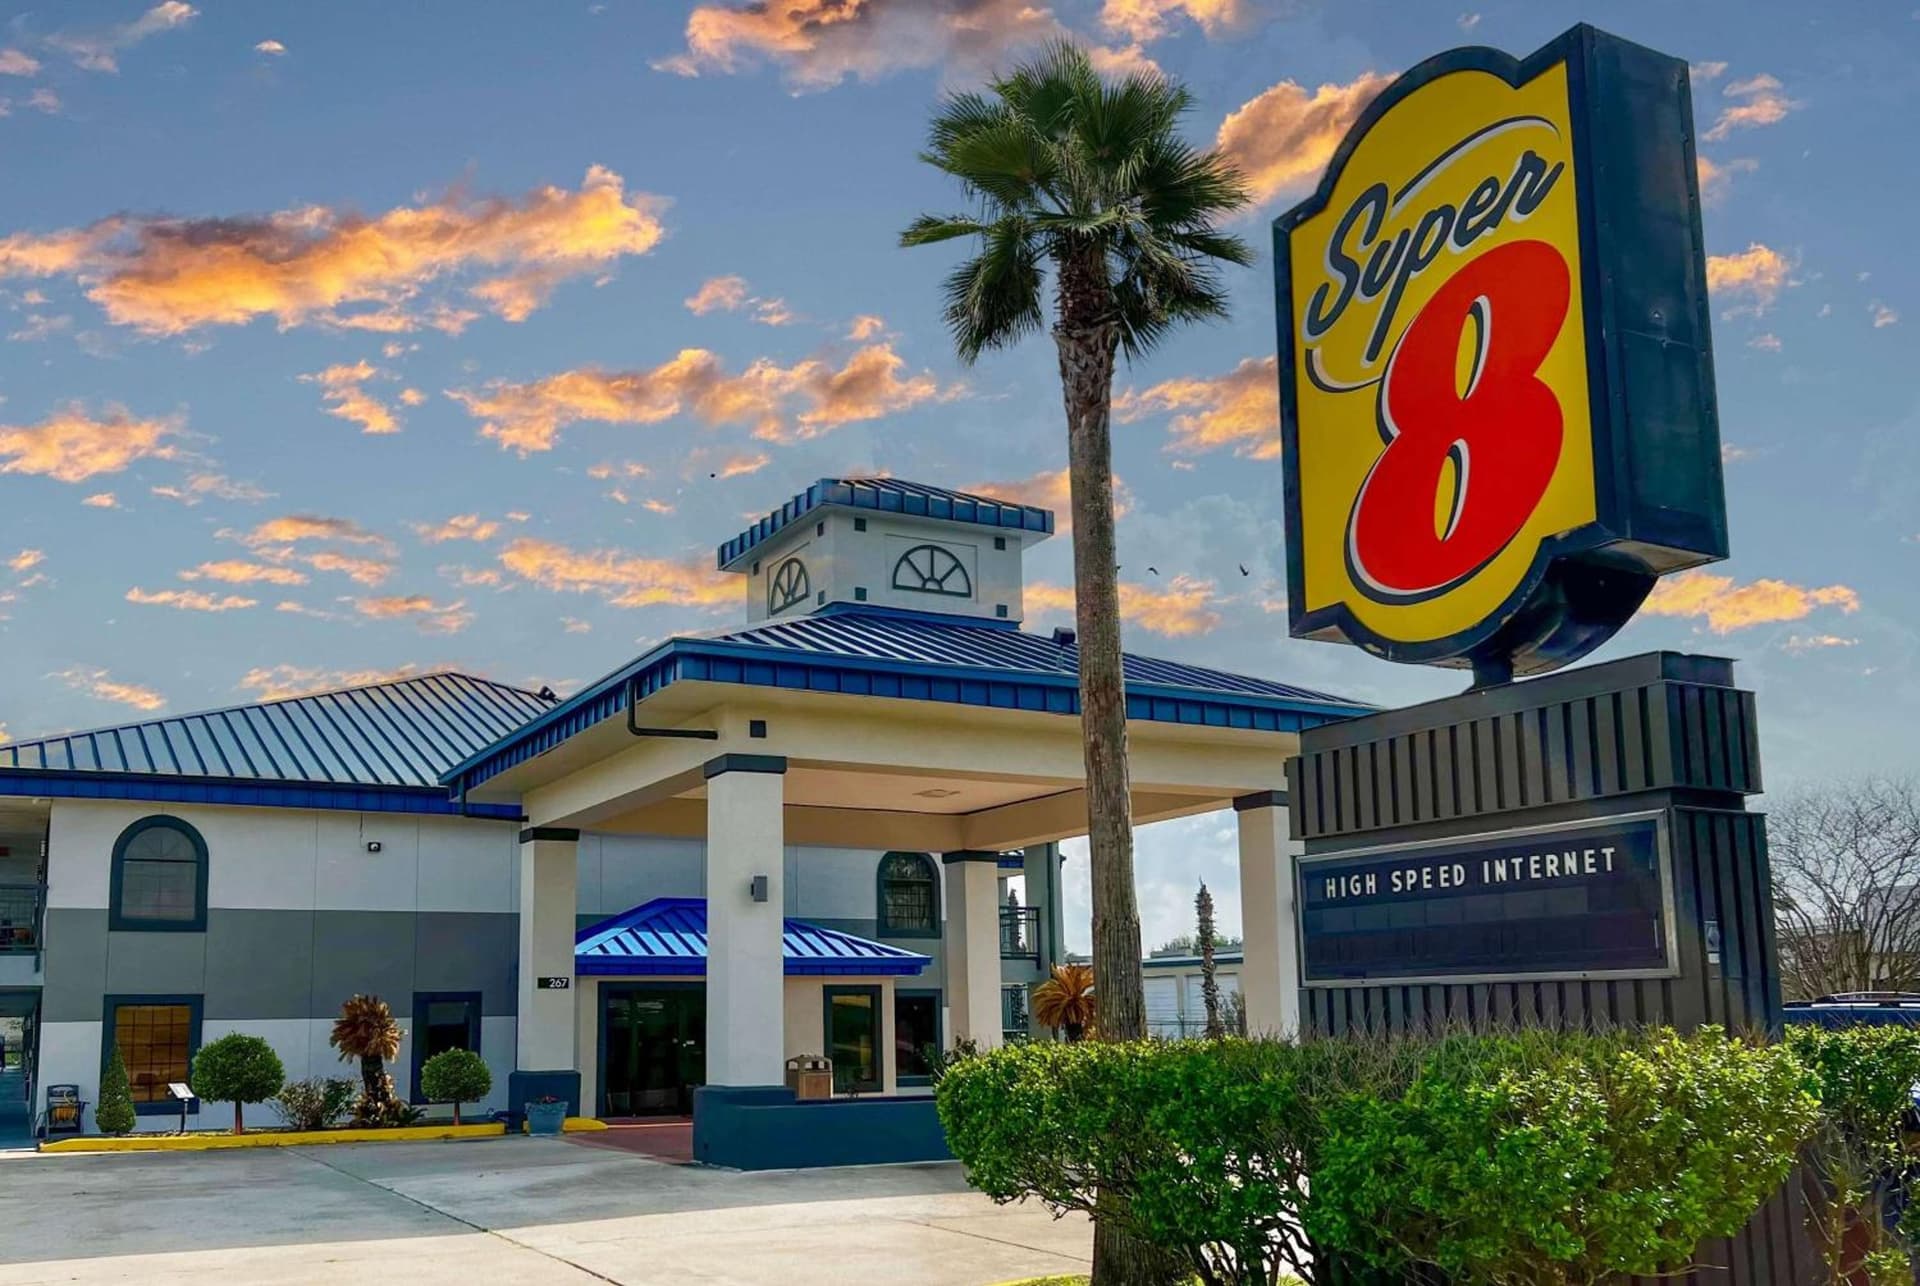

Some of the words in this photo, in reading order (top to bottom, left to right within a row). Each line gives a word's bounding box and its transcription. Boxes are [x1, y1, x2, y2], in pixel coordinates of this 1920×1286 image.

[1303, 150, 1566, 366] Super
[1344, 239, 1571, 605] 8
[1325, 872, 1377, 899] HIGH
[1391, 864, 1466, 893] SPEED
[1483, 846, 1616, 884] INTERNET
[549, 978, 568, 988] 267
